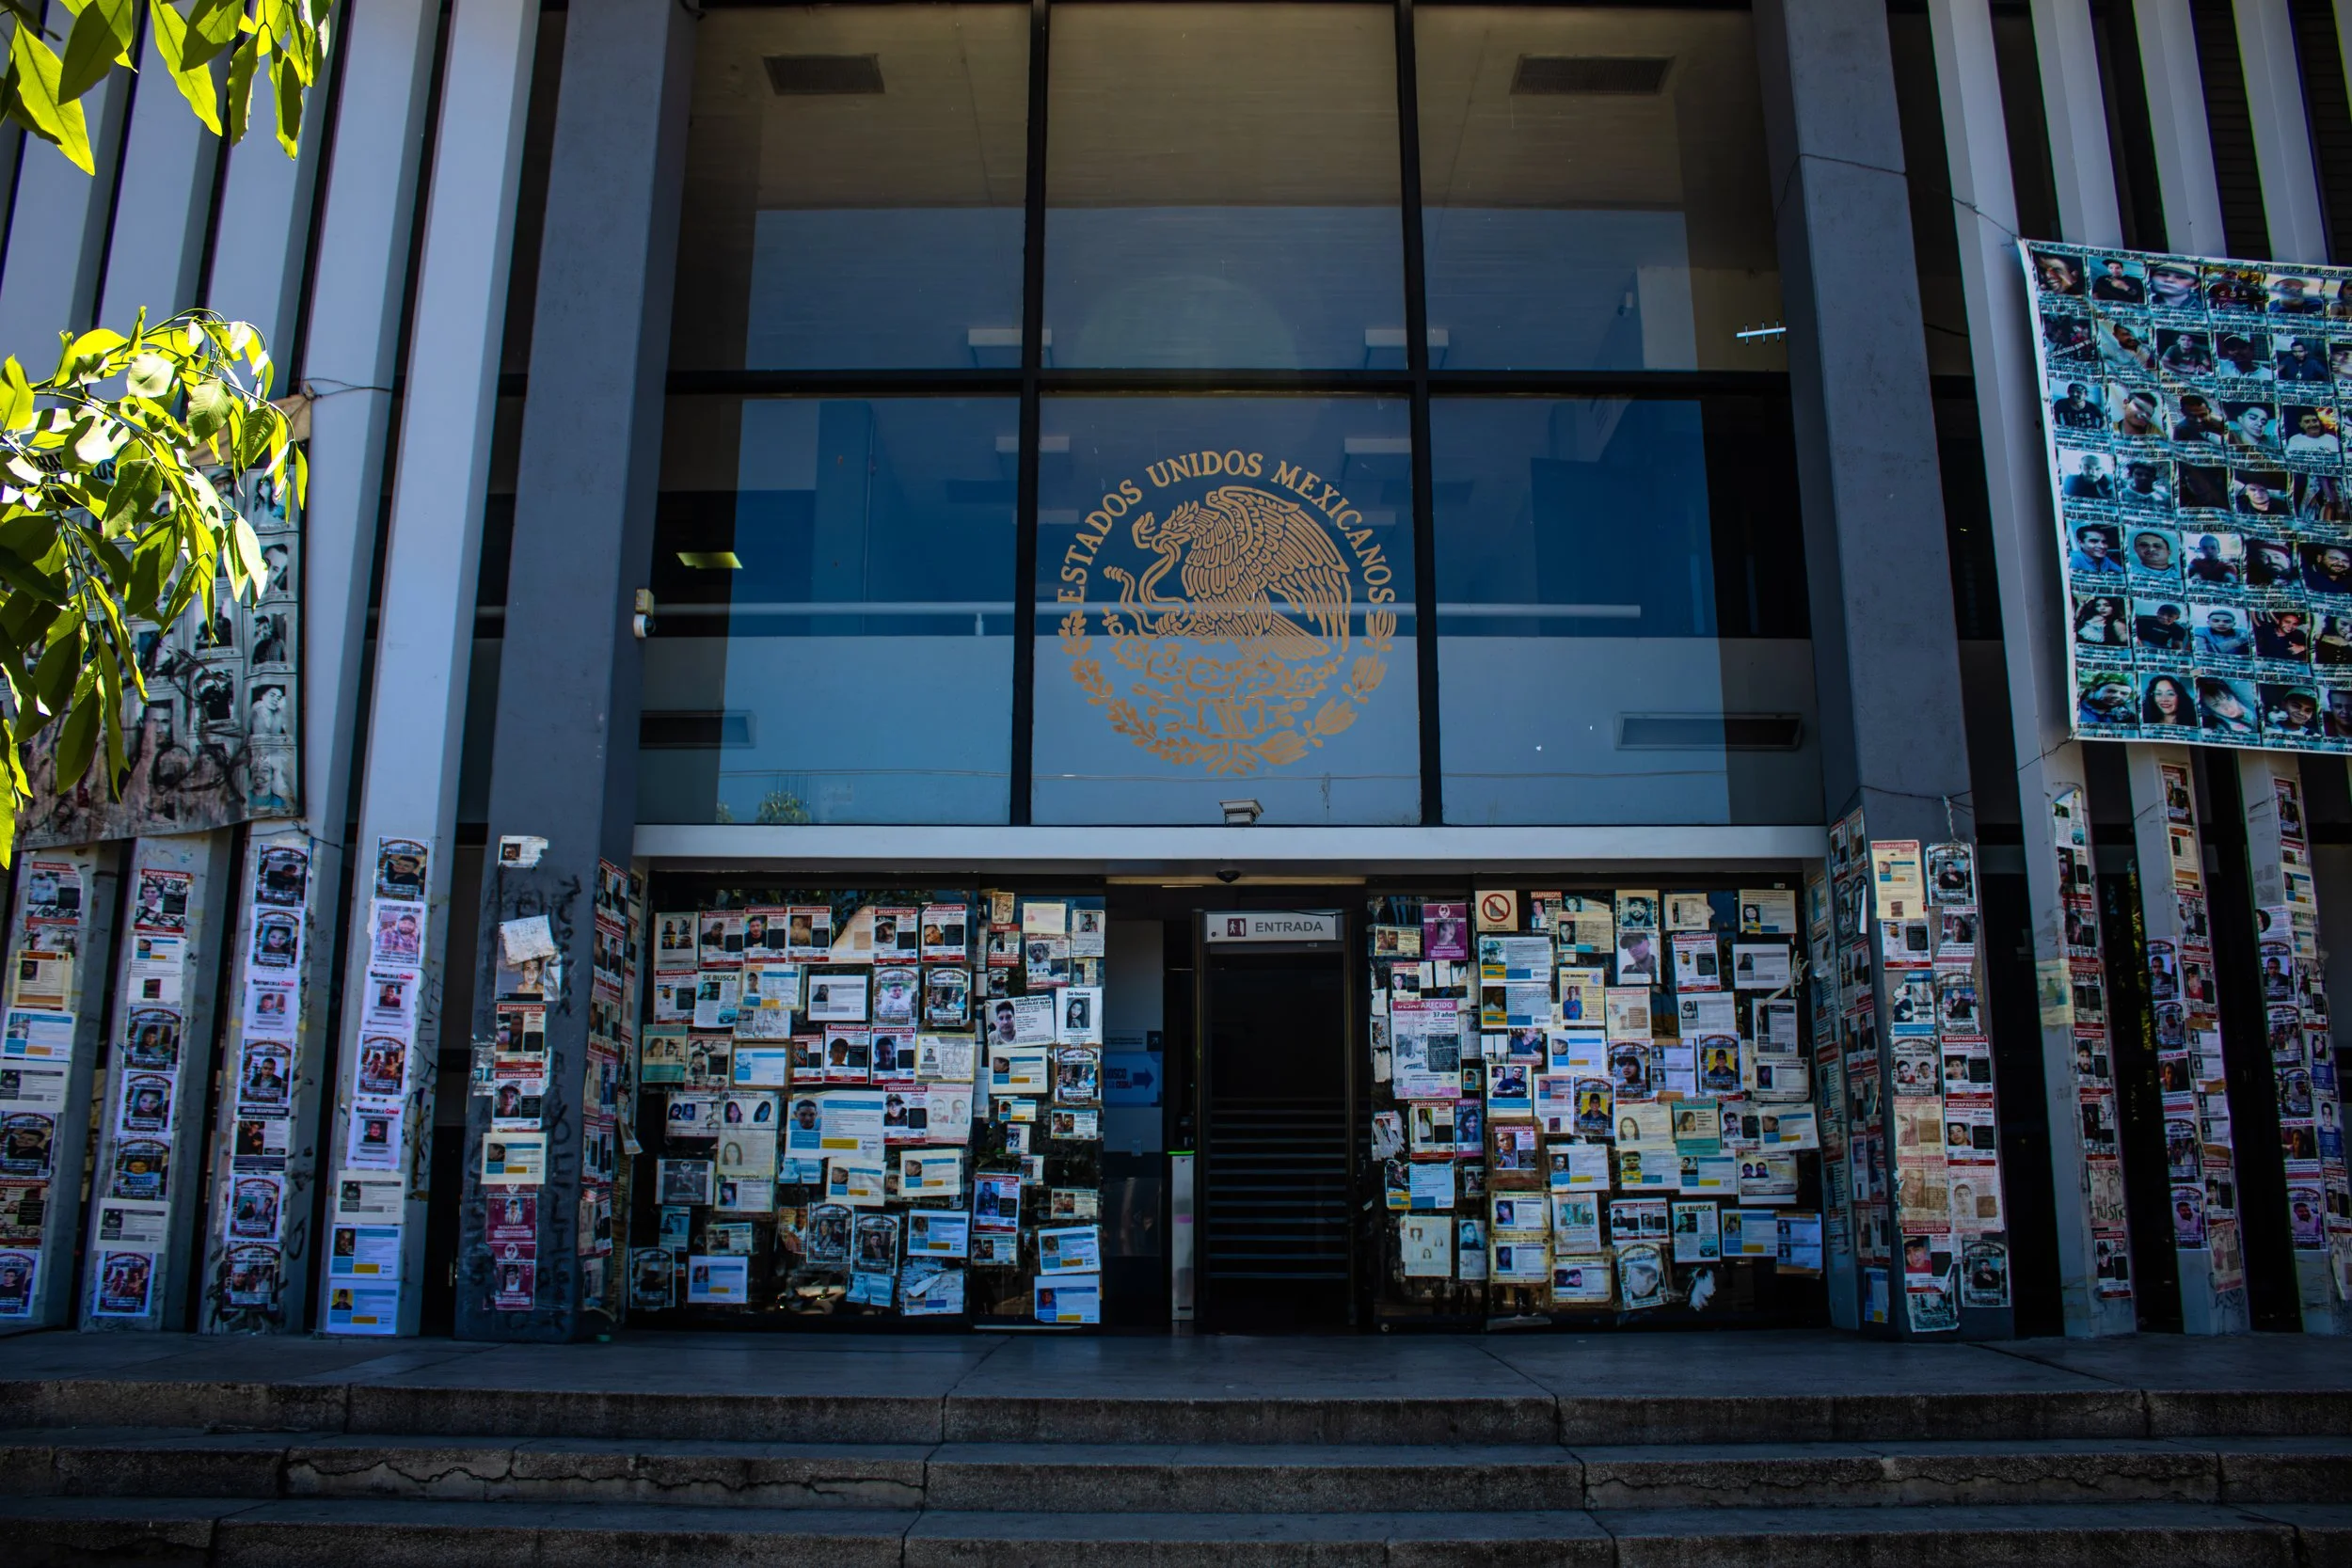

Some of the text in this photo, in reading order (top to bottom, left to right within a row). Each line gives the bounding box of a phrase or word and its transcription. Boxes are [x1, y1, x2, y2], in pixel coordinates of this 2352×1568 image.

[1057, 449, 1396, 605] ESTADOS UNIDOS MEXICANOS
[1255, 921, 1324, 933] ENTRADA
[1689, 1204, 1712, 1212] BUSCA
